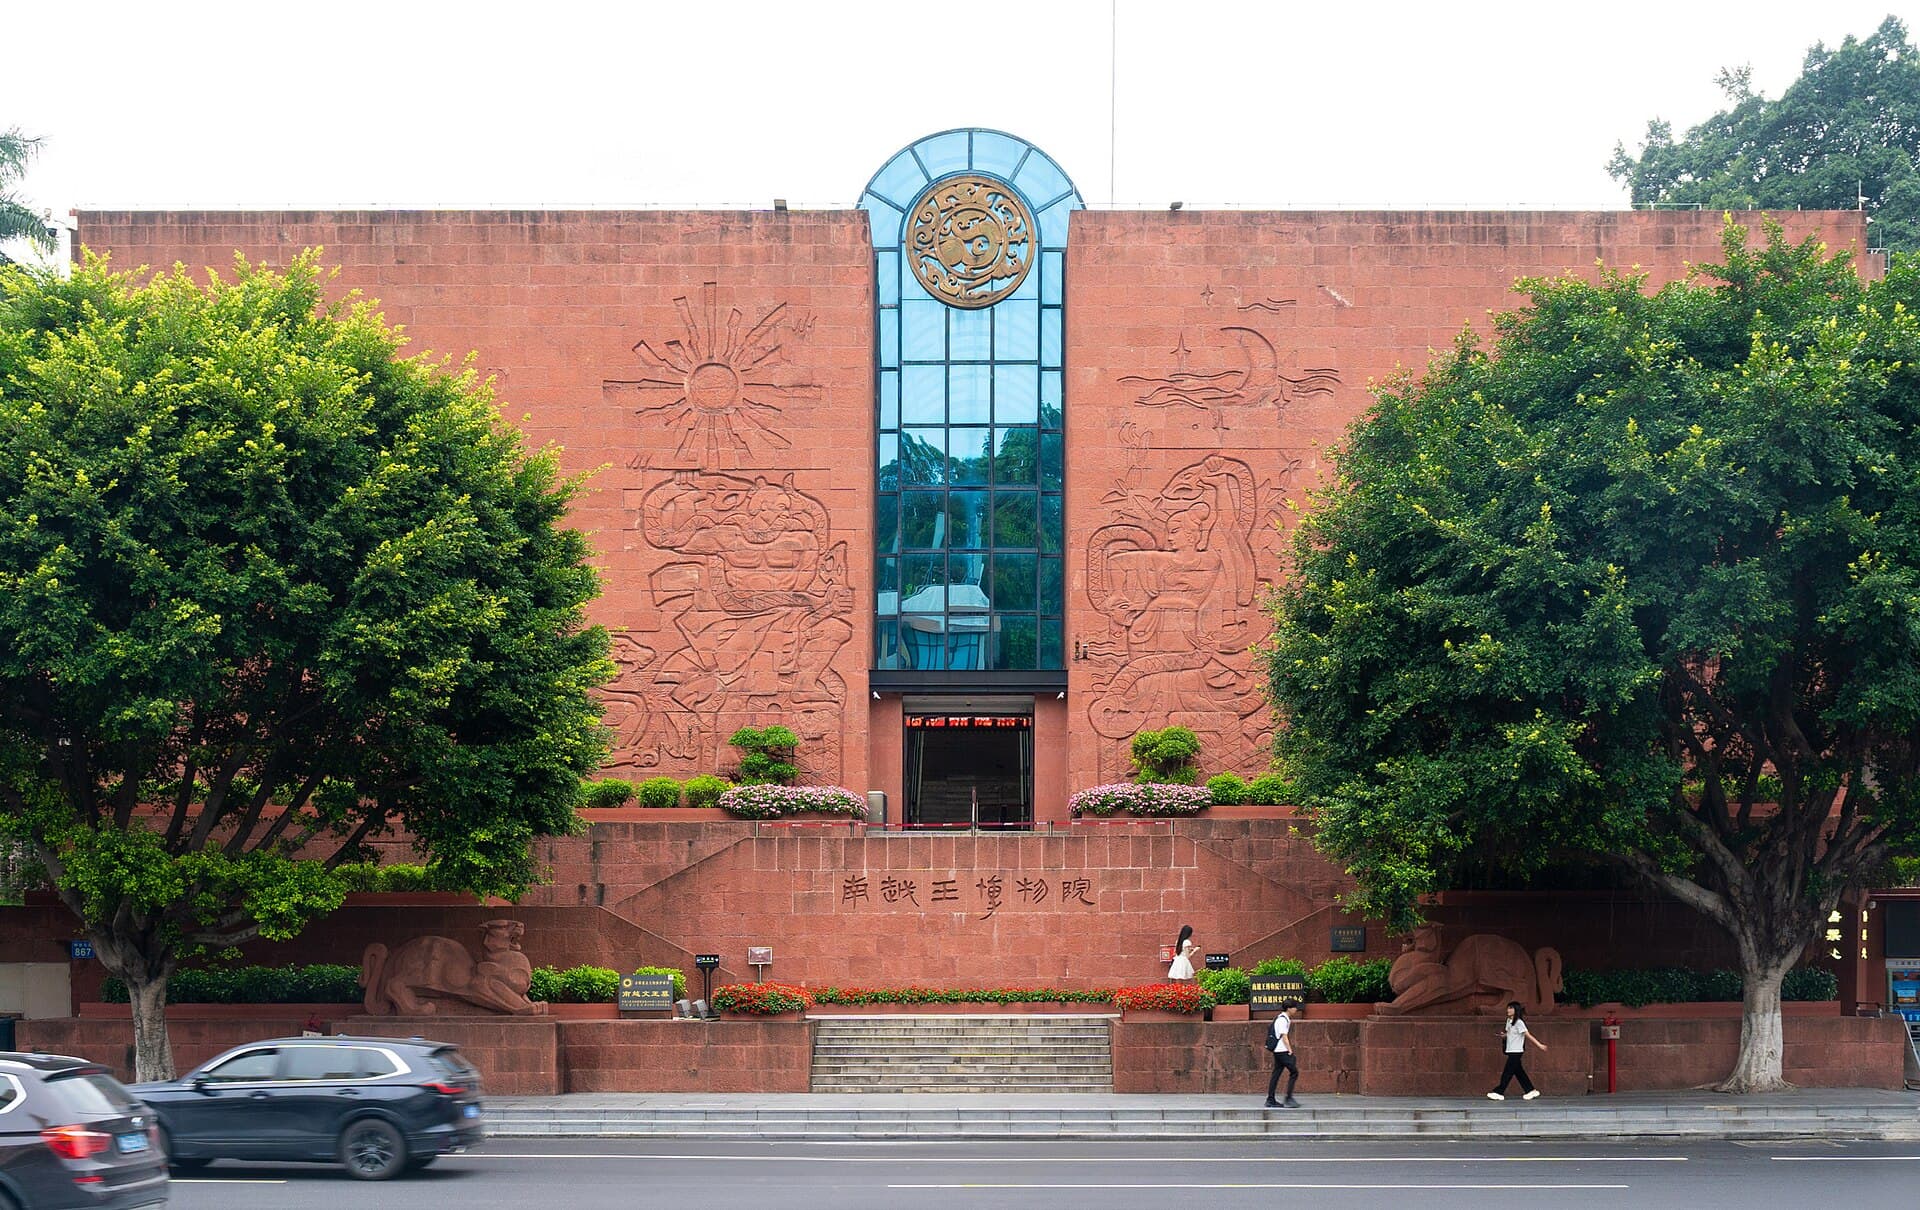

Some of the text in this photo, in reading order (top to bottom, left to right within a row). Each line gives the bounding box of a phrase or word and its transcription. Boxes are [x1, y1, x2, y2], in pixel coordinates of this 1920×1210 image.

[842, 874, 1095, 920] 南越王博物院
[75, 948, 91, 956] 867
